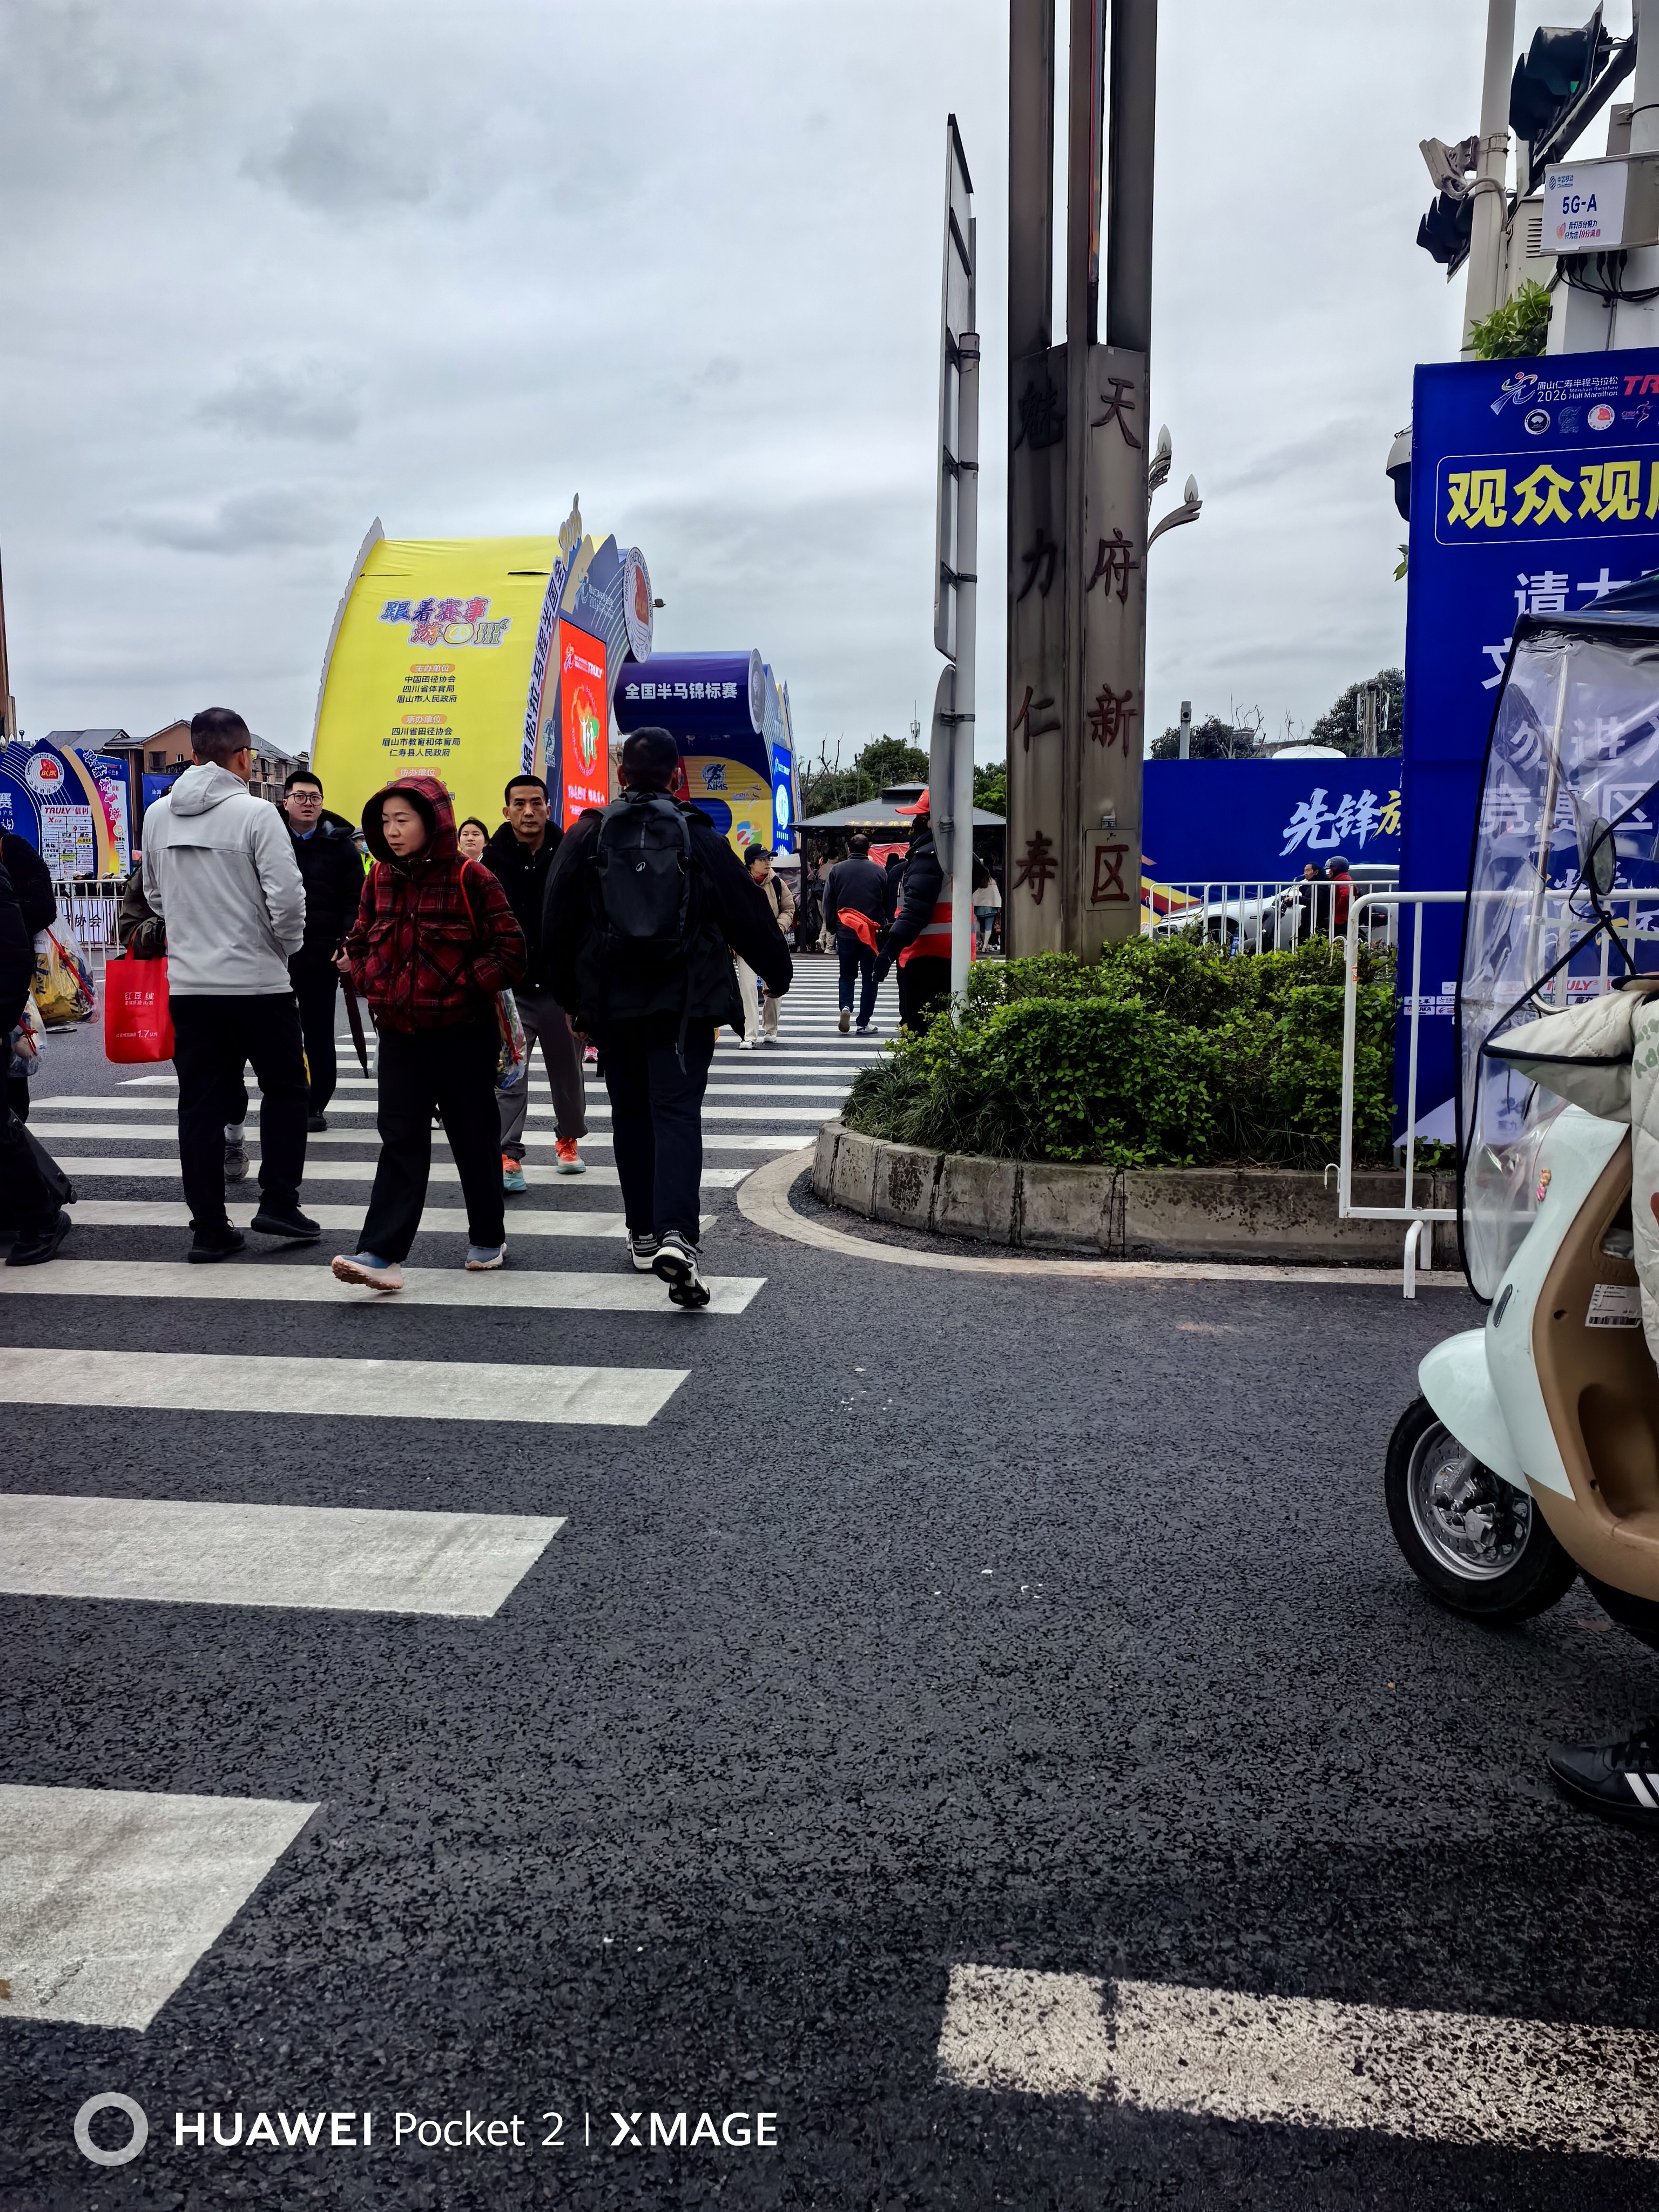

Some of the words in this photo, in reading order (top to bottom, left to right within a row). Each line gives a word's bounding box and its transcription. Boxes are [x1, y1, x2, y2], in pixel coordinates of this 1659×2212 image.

[1562, 193, 1597, 214] 5G-A
[1537, 376, 1618, 390] 眉山仁寿半程马拉松
[1537, 389, 1567, 402] 2026
[1584, 389, 1618, 399] Marathon
[1448, 460, 1659, 529] 观众观
[1514, 568, 1658, 617] 请大
[382, 597, 488, 623] 跟着赛事
[1087, 376, 1141, 904] 天府新区
[415, 664, 450, 672] 主办单位
[587, 662, 603, 679] TRULY
[404, 675, 456, 683] 中国田径协会
[402, 685, 455, 693] 四川省体育局
[625, 682, 738, 699] 全国半马锦标赛
[396, 694, 457, 703] 眉山市人民政府
[406, 716, 442, 724] 承办单位
[392, 727, 453, 736] 四川省田径协会
[382, 738, 461, 746] 眉山市教育和体育局
[389, 748, 450, 757] 仁寿县人民政府
[75, 807, 89, 815] 信利
[1546, 980, 1592, 991] TULY
[138, 1030, 150, 1038] 1.7
